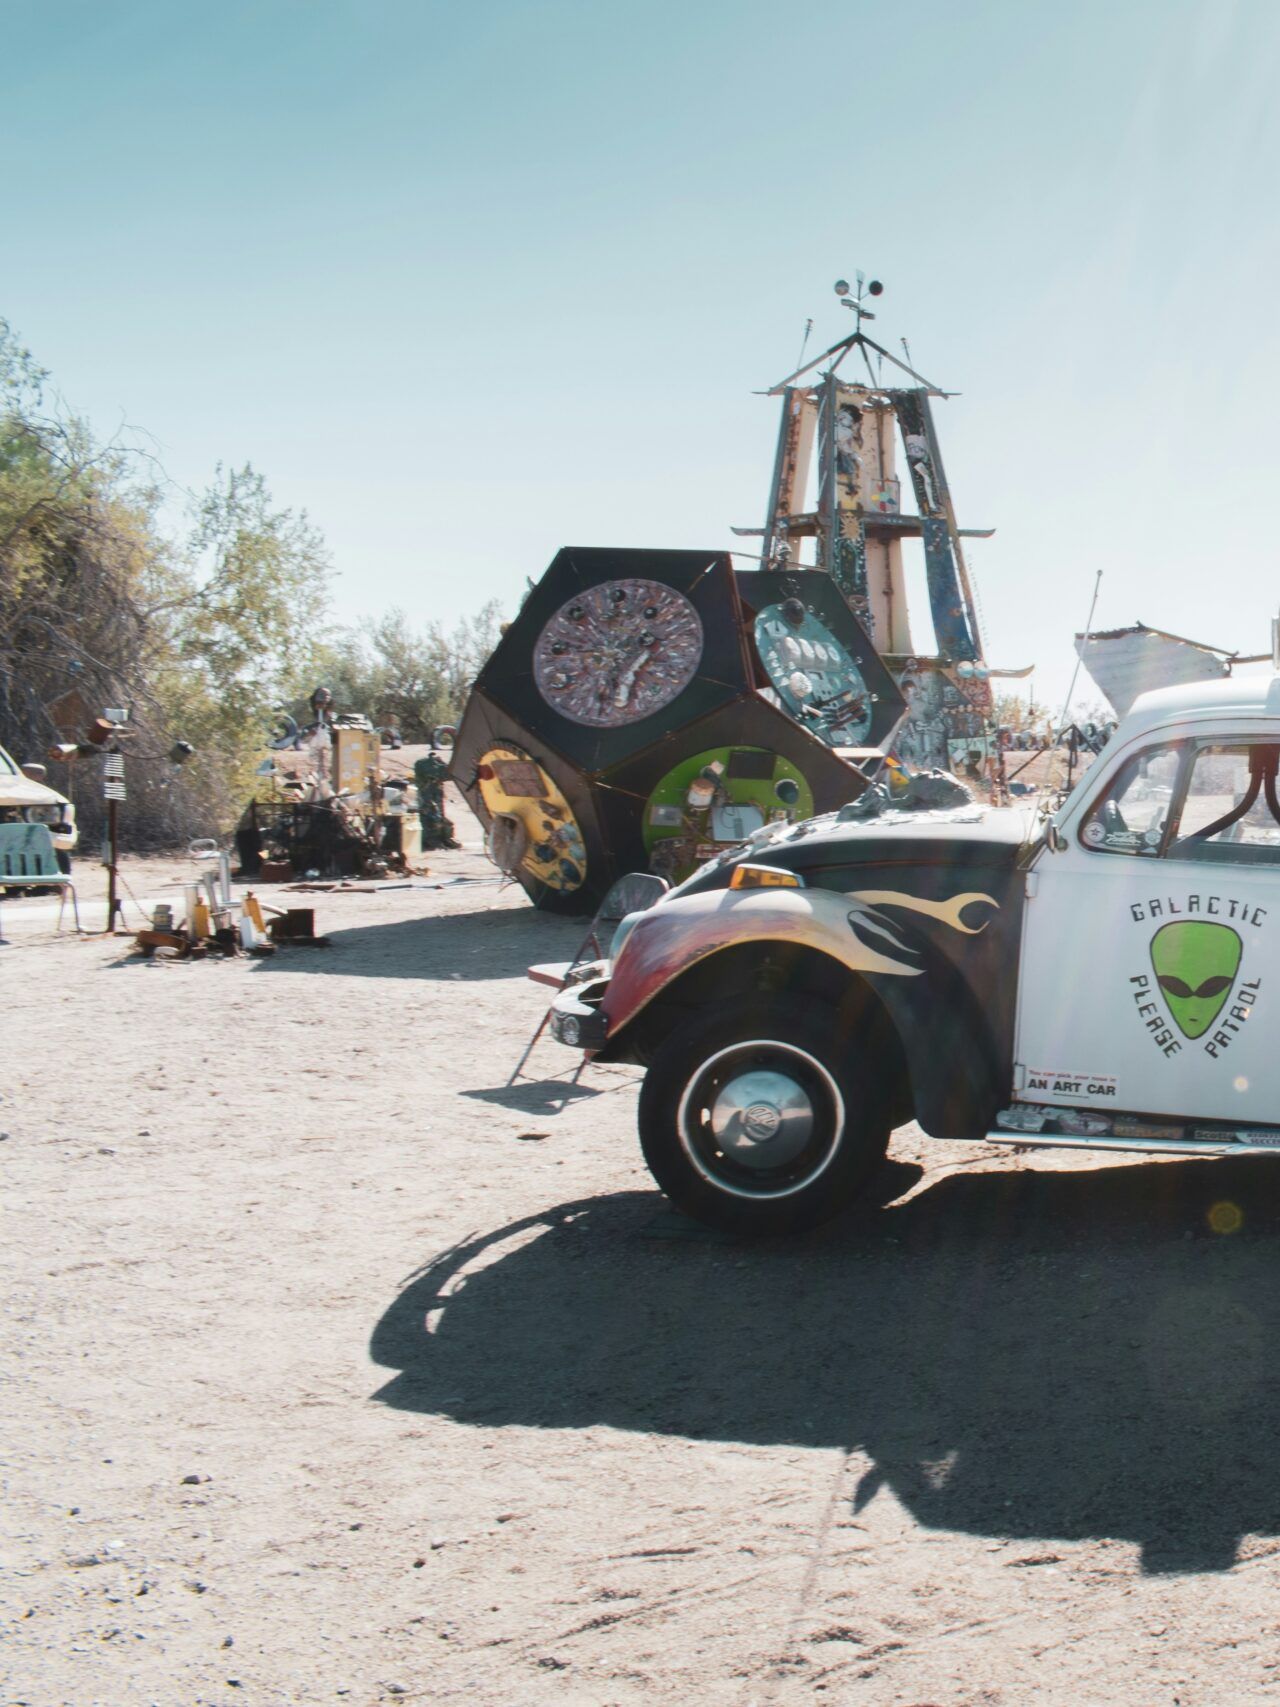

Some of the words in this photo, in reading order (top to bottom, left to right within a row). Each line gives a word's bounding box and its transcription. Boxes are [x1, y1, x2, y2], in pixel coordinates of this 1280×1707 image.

[1130, 895, 1267, 927] GALACTIC
[1129, 974, 1182, 1058] PLEASE
[1204, 978, 1261, 1059] PATROL
[1028, 1079, 1047, 1089] AN
[1053, 1081, 1082, 1092] ART
[1087, 1084, 1116, 1096] CAR
